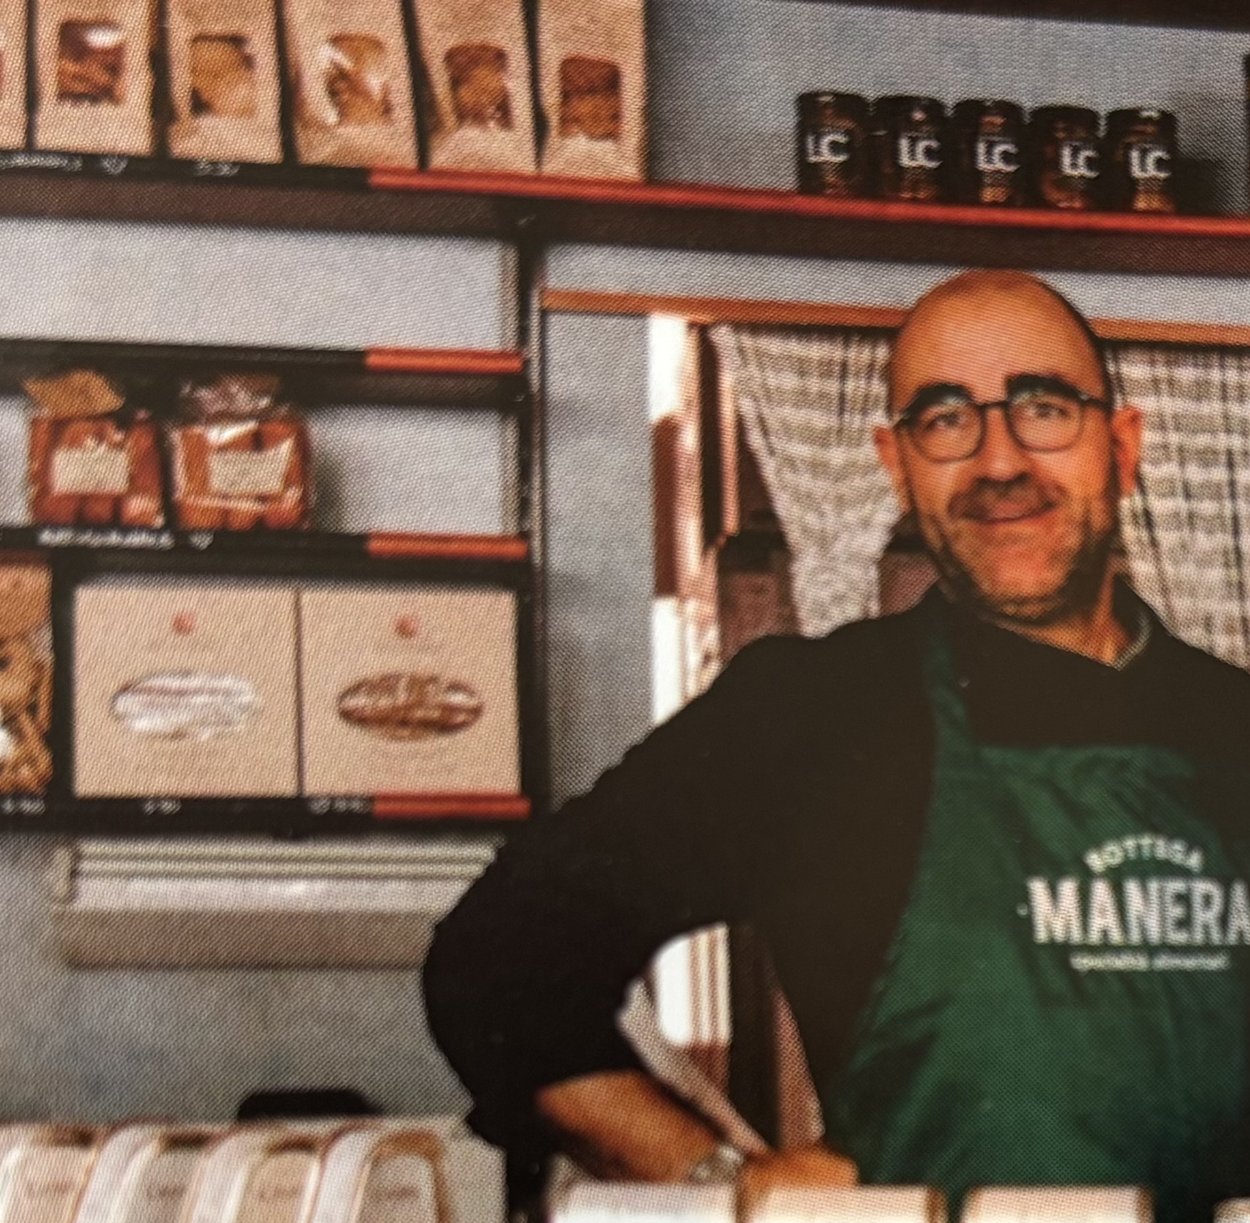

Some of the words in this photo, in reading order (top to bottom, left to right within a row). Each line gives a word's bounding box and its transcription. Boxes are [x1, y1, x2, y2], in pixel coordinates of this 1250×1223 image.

[807, 133, 848, 164] LC
[900, 137, 941, 169] LC
[977, 140, 1019, 172] LC
[1061, 142, 1099, 177] LC
[1130, 145, 1170, 180] LC
